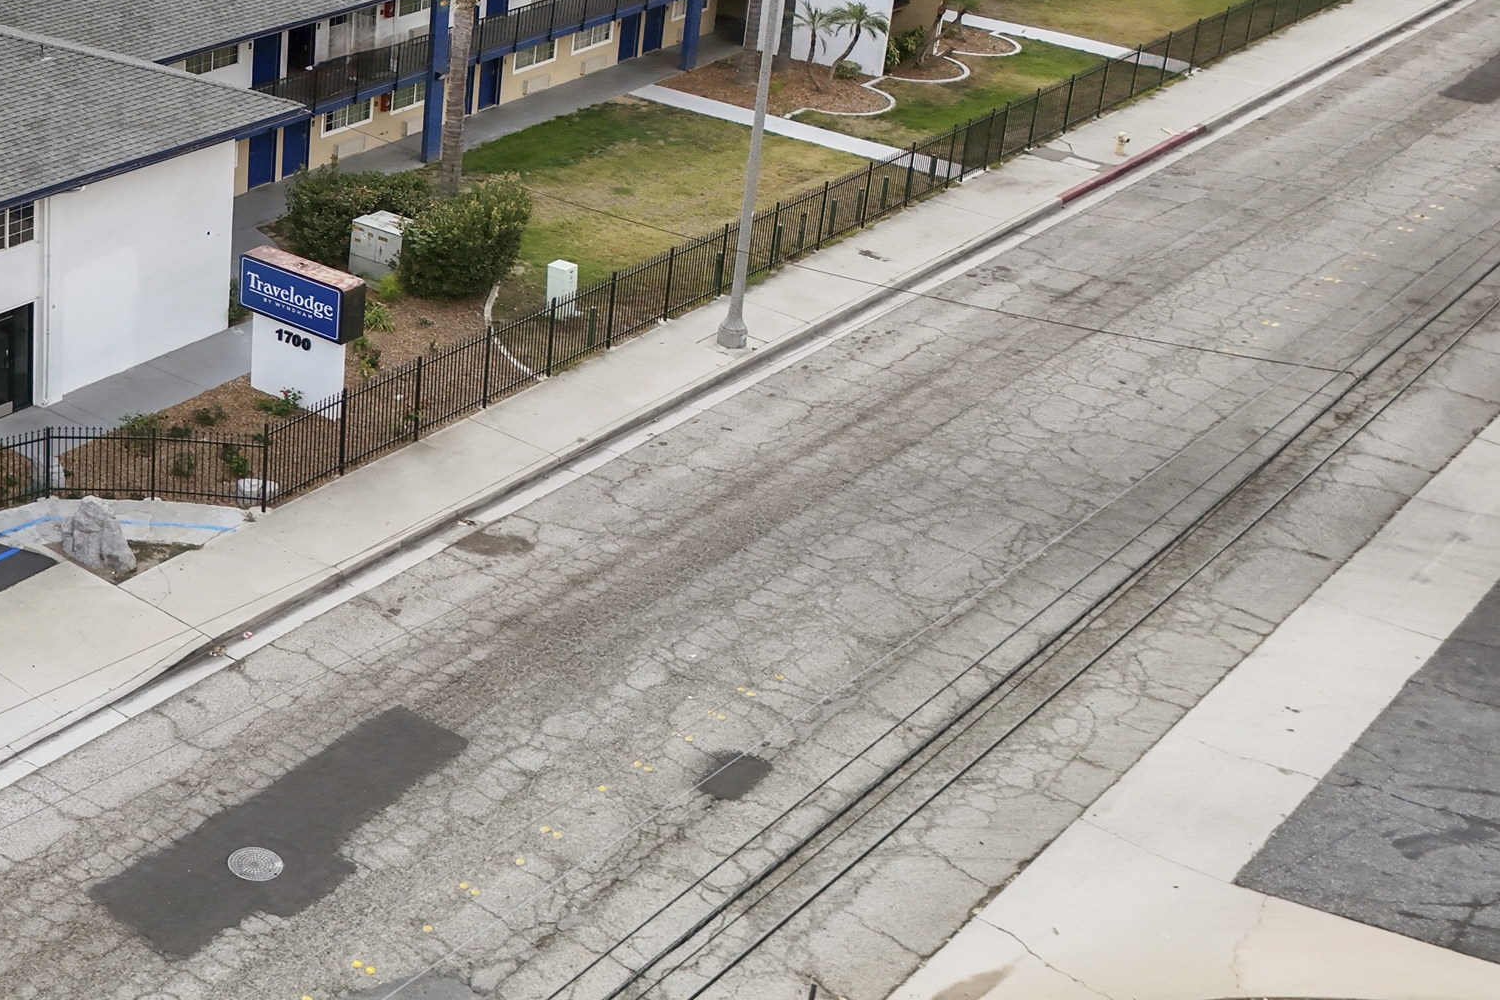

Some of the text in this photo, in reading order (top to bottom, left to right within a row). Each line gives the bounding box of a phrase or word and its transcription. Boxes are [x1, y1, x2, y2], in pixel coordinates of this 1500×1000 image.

[246, 270, 334, 319] Travelodge
[274, 301, 313, 320] WYNDHAM
[275, 328, 312, 351] 1700
